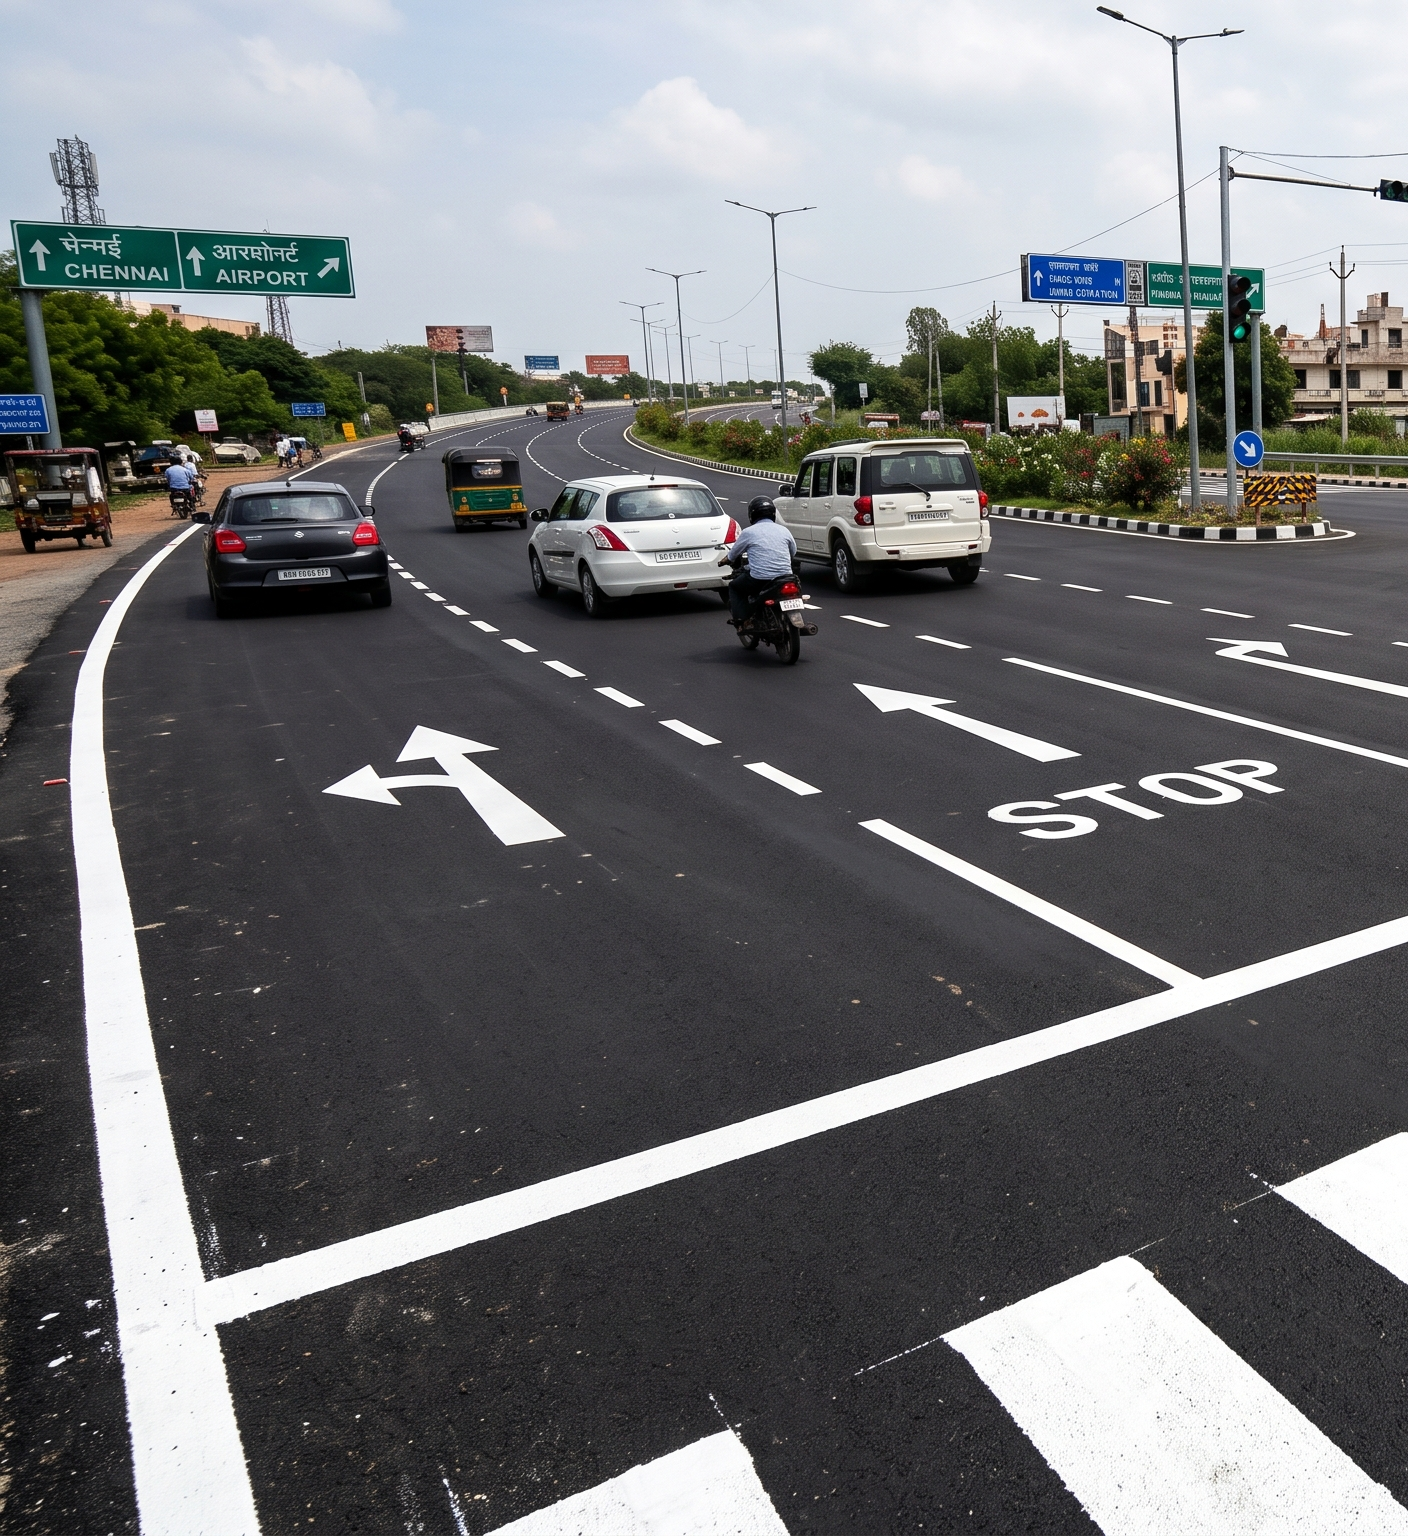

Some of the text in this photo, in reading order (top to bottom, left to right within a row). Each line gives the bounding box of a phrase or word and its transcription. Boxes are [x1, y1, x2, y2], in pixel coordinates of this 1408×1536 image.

[64, 263, 169, 282] CHENNAI
[216, 268, 309, 287] AIRPORT
[987, 758, 1286, 840] STOP
